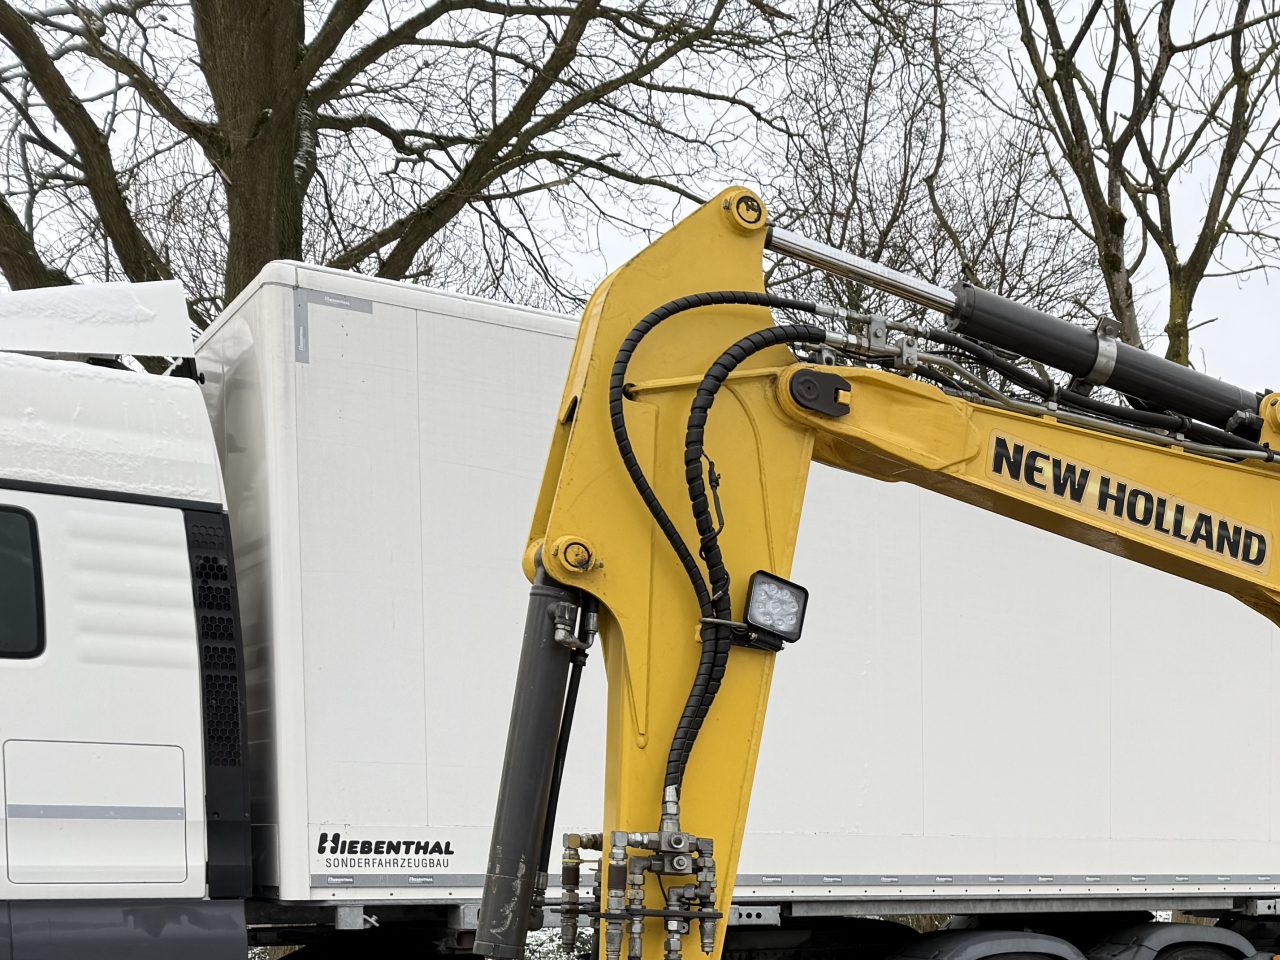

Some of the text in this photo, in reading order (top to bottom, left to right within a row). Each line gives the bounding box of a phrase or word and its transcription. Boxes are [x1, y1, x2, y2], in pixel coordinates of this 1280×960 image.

[991, 436, 1267, 567] NEW HOLLAND
[317, 832, 455, 856] HIEBENTHAL
[325, 857, 450, 869] SONDERFAHRZEUGBAU
